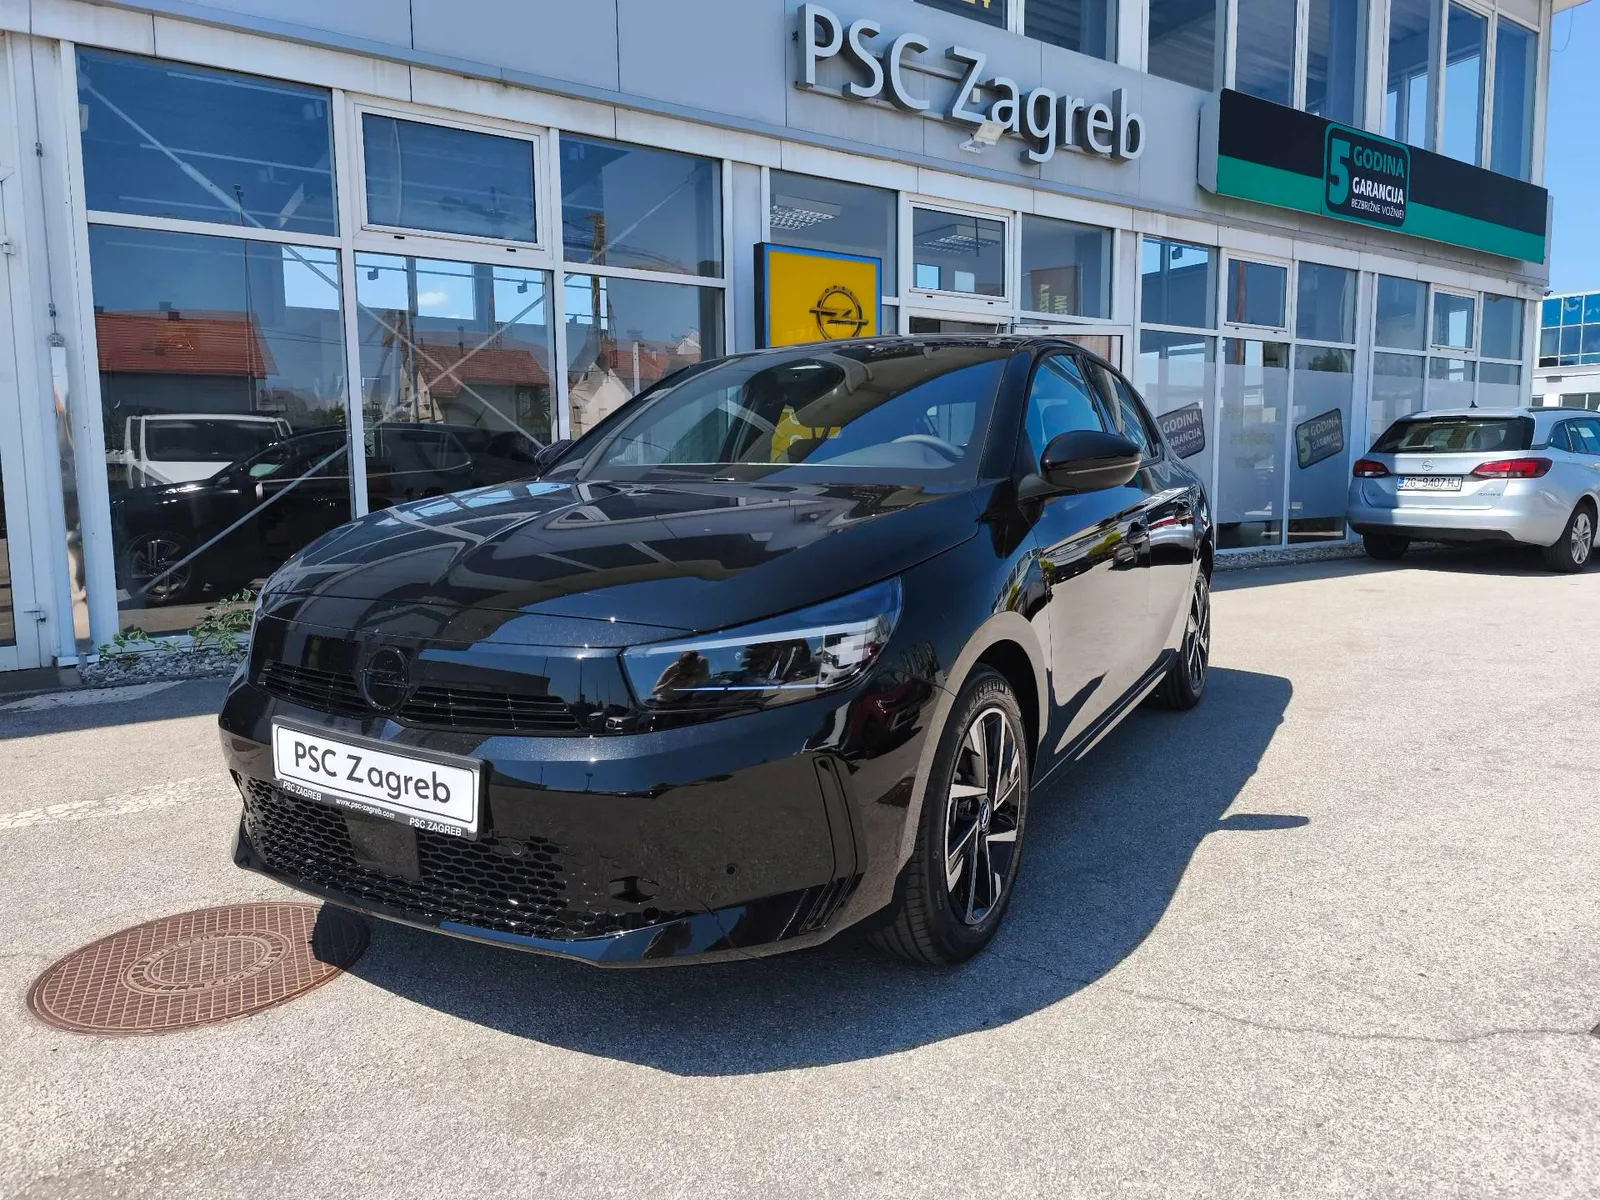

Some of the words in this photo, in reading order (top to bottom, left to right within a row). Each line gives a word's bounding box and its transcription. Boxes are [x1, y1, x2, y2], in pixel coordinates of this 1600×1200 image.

[799, 3, 930, 111] PSC
[945, 46, 1146, 163] Zagreb
[1328, 137, 1350, 205] 5
[1353, 145, 1404, 178] GODINA
[1352, 177, 1404, 205] GARANCIJA
[1351, 198, 1380, 214] BEZBRIŽNE
[1162, 410, 1199, 434] GODINA
[1311, 416, 1339, 436] GODINA
[294, 740, 338, 778] PSC
[346, 754, 451, 804] Zagreb
[282, 780, 297, 793] PSC
[296, 782, 322, 802] ZAGREB
[335, 797, 396, 820] www.psc-zagreb.com
[409, 816, 427, 830] PSC
[427, 818, 462, 838] ZAGREB
